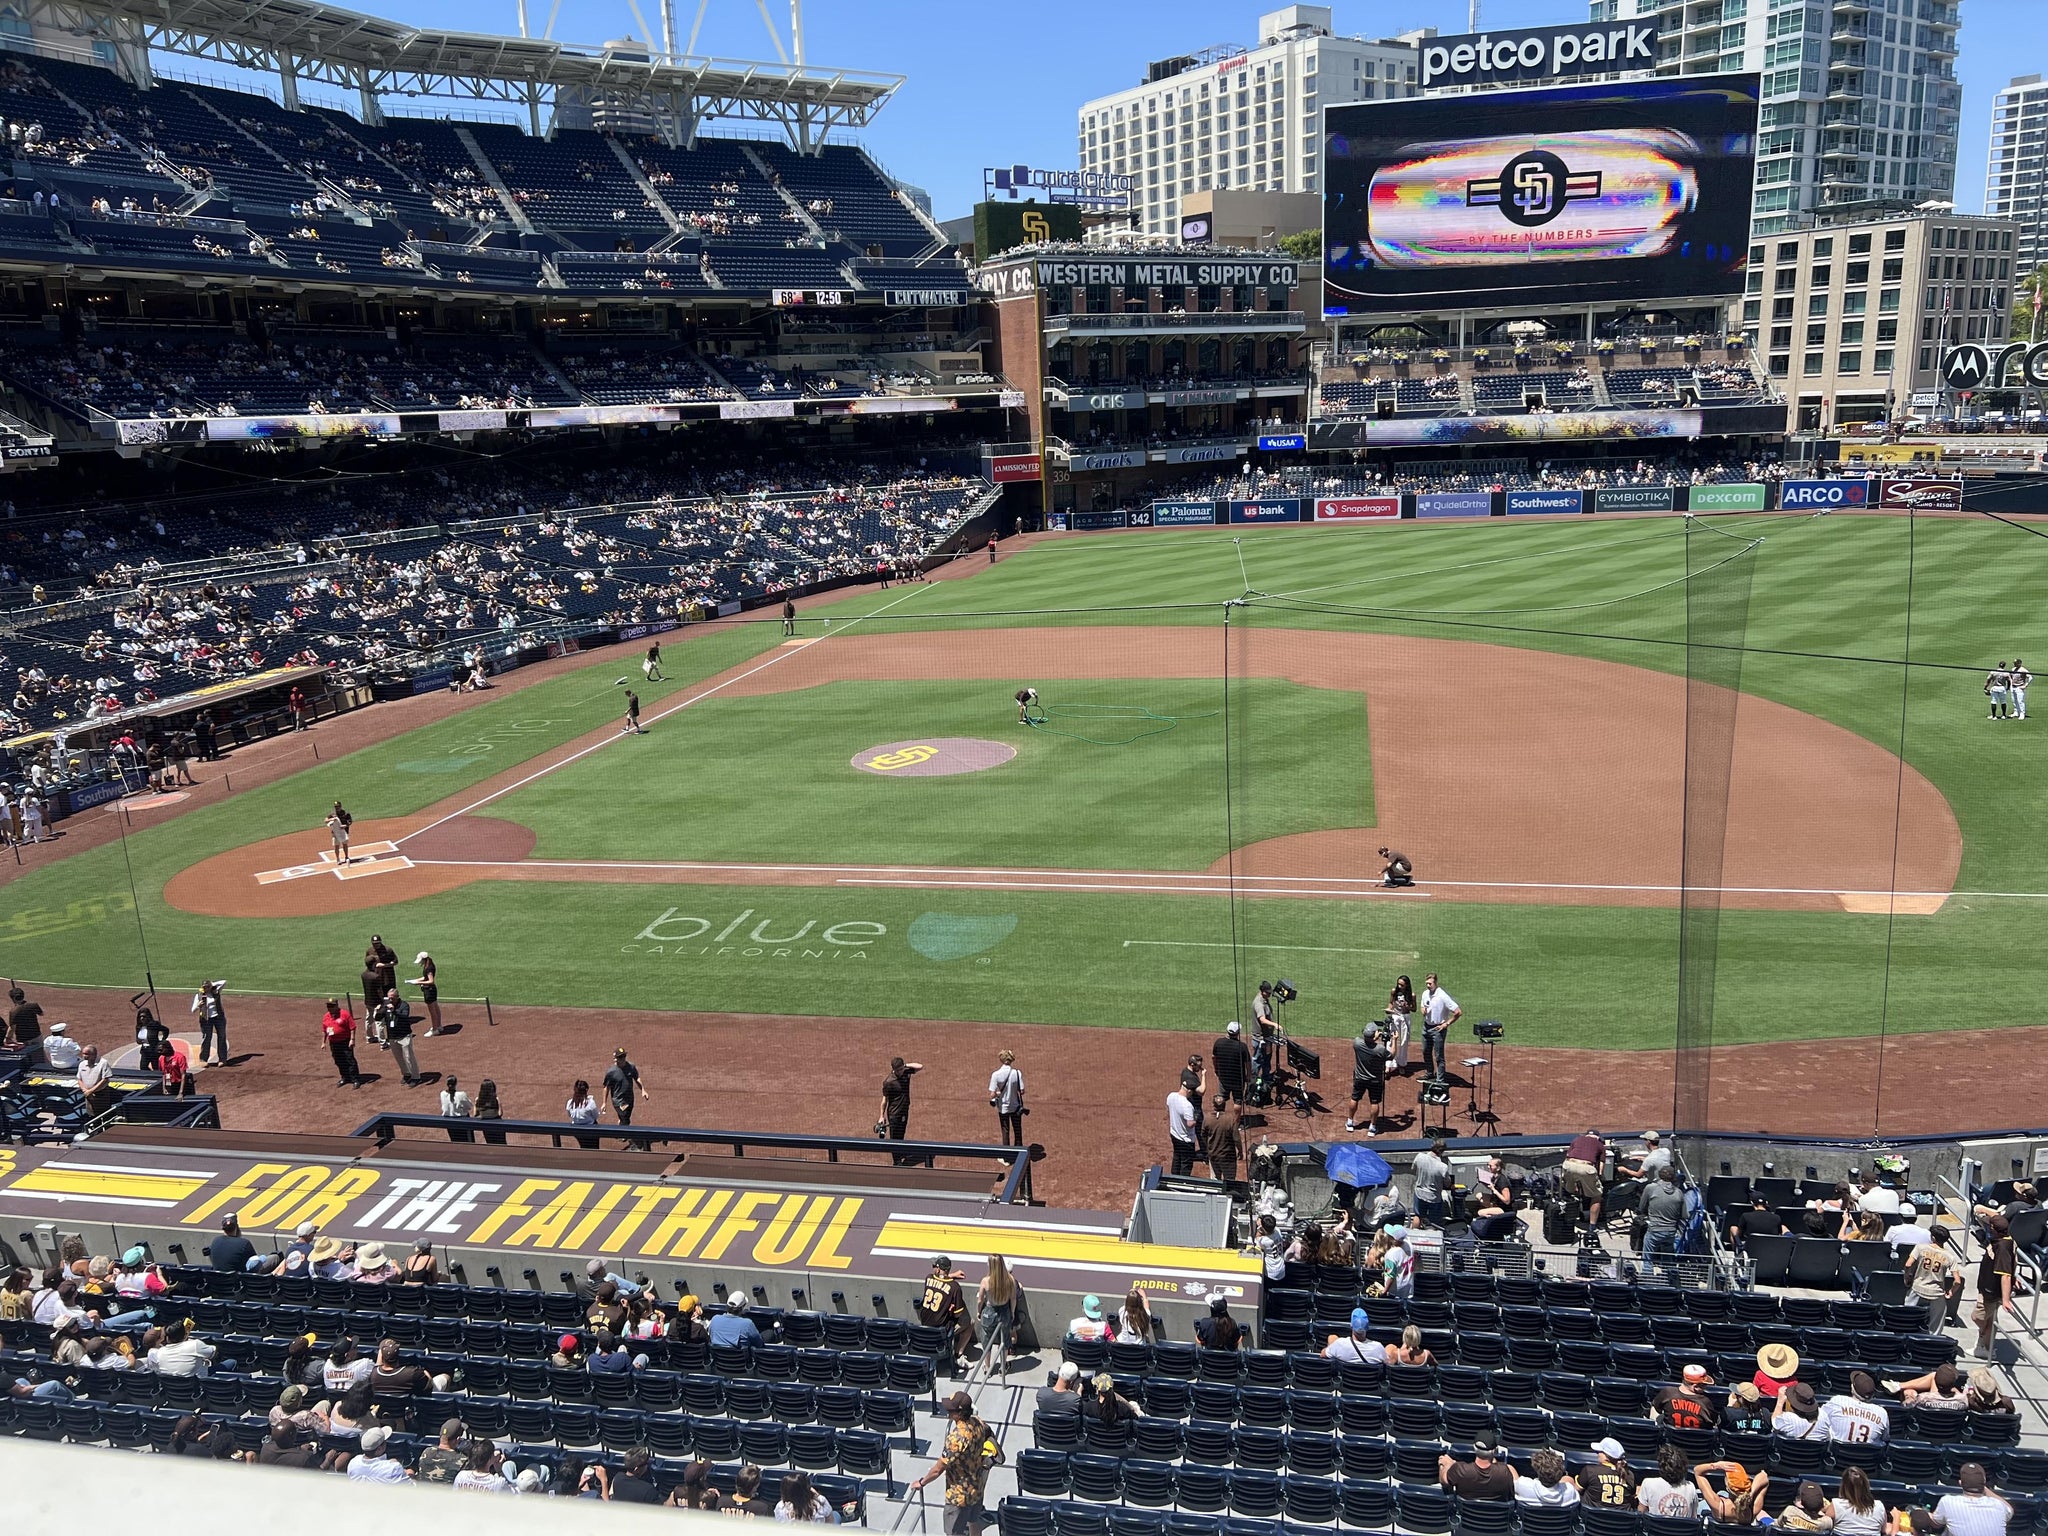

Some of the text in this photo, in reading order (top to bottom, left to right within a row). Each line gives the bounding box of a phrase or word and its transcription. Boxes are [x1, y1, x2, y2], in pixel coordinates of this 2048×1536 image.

[1423, 25, 1654, 85] petco park
[1032, 169, 1129, 190] QuidelOrtho
[1469, 229, 1593, 245] BY THE NUMBERS
[1037, 263, 1297, 285] WESTERN METAL SUPPLY CO.
[815, 291, 842, 305] 12:50
[895, 291, 959, 305] CUTWATER
[1090, 394, 1125, 409] ORIS
[1002, 463, 1028, 472] MISSION
[1053, 470, 1070, 482] 336
[1511, 497, 1570, 508] Southwest
[1598, 492, 1670, 502] CYMBIOTIKA
[1783, 487, 1843, 503] ARCO
[1171, 506, 1212, 516] Palomar
[1244, 505, 1285, 516] us bank
[1341, 503, 1391, 514] Snapdragon
[1433, 500, 1487, 510] QuidelOrtho
[1131, 513, 1150, 525] 342
[77, 781, 134, 807] Southwet
[634, 906, 887, 946] blue
[620, 945, 868, 960] CALIFORNIA
[180, 1163, 865, 1269] FOR THE FAITHFUL
[1132, 1280, 1178, 1292] PADRES
[922, 1288, 943, 1312] 23
[1671, 1398, 1702, 1415] GWYNN
[1841, 1406, 1883, 1426] MACHADO
[1847, 1421, 1870, 1443] 13
[1601, 1483, 1625, 1505] 23
